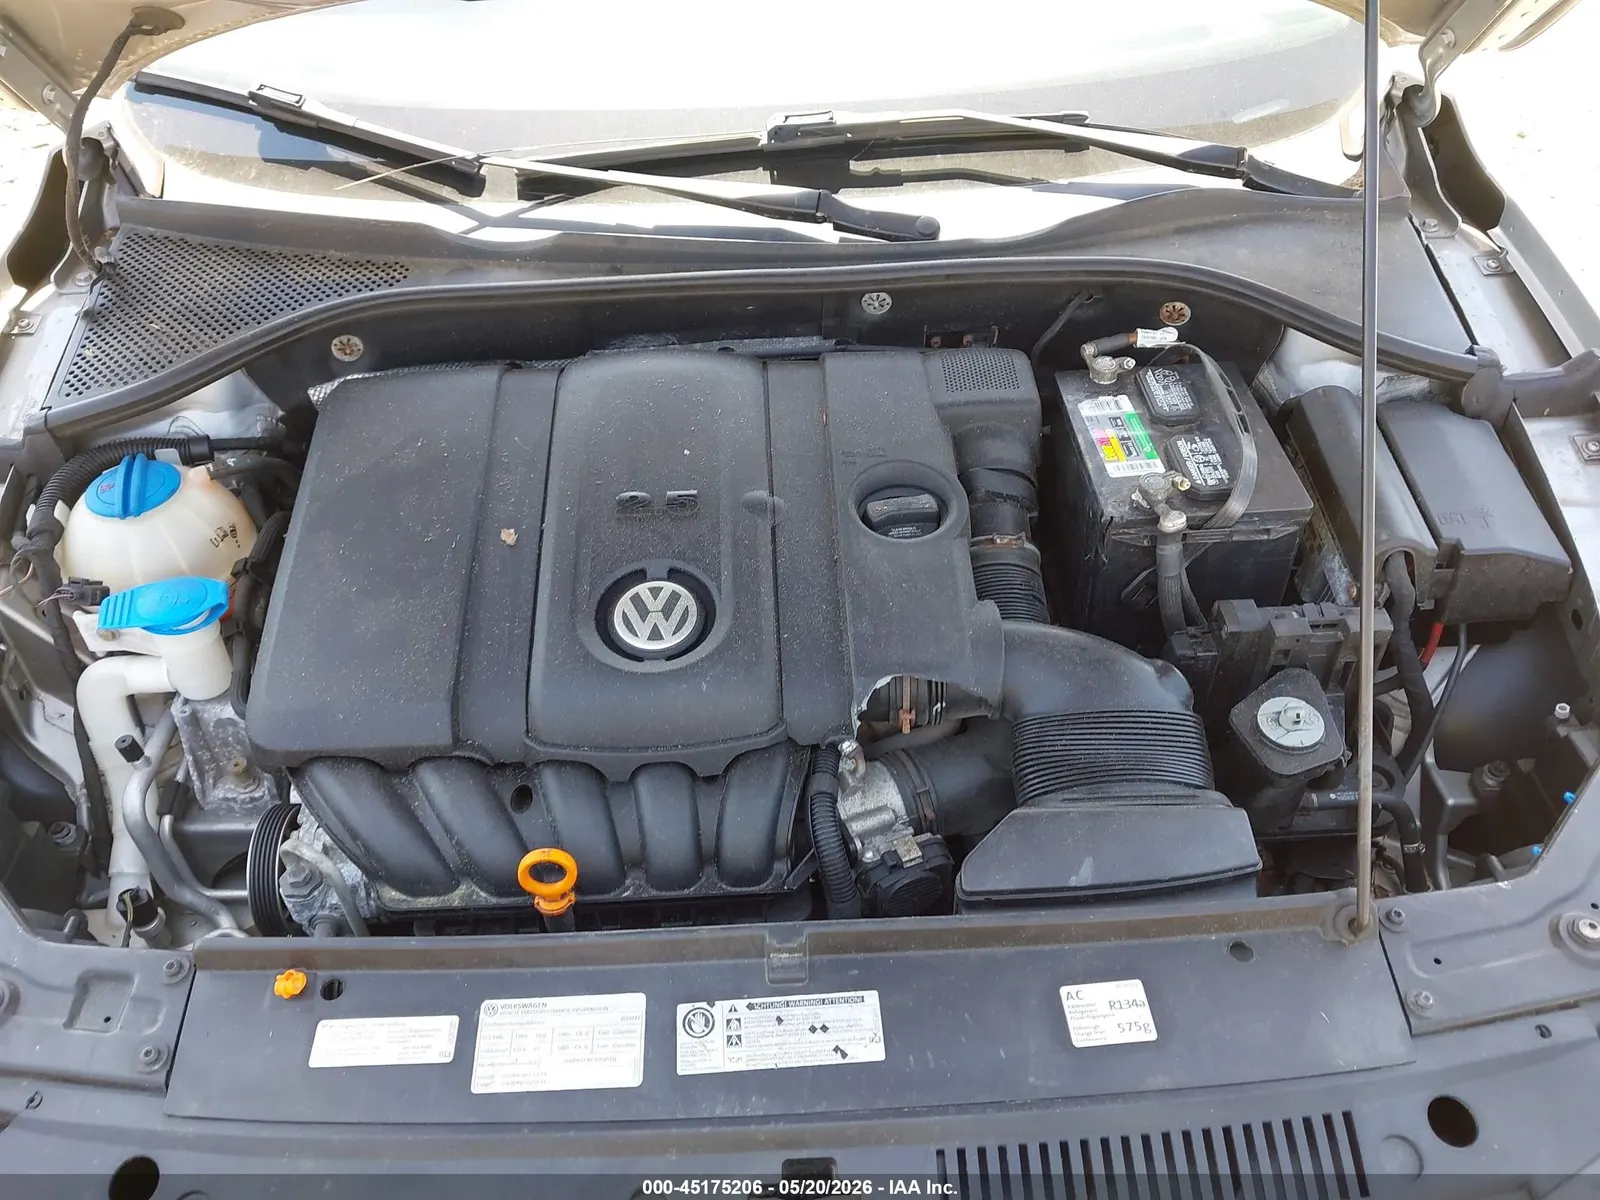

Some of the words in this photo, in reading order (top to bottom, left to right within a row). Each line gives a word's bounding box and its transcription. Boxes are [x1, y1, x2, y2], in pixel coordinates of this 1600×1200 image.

[1066, 990, 1084, 1001] AC
[500, 1002, 547, 1010] VOLKSWAGEN
[1108, 999, 1146, 1010] R134a
[1117, 1021, 1152, 1034] 575g
